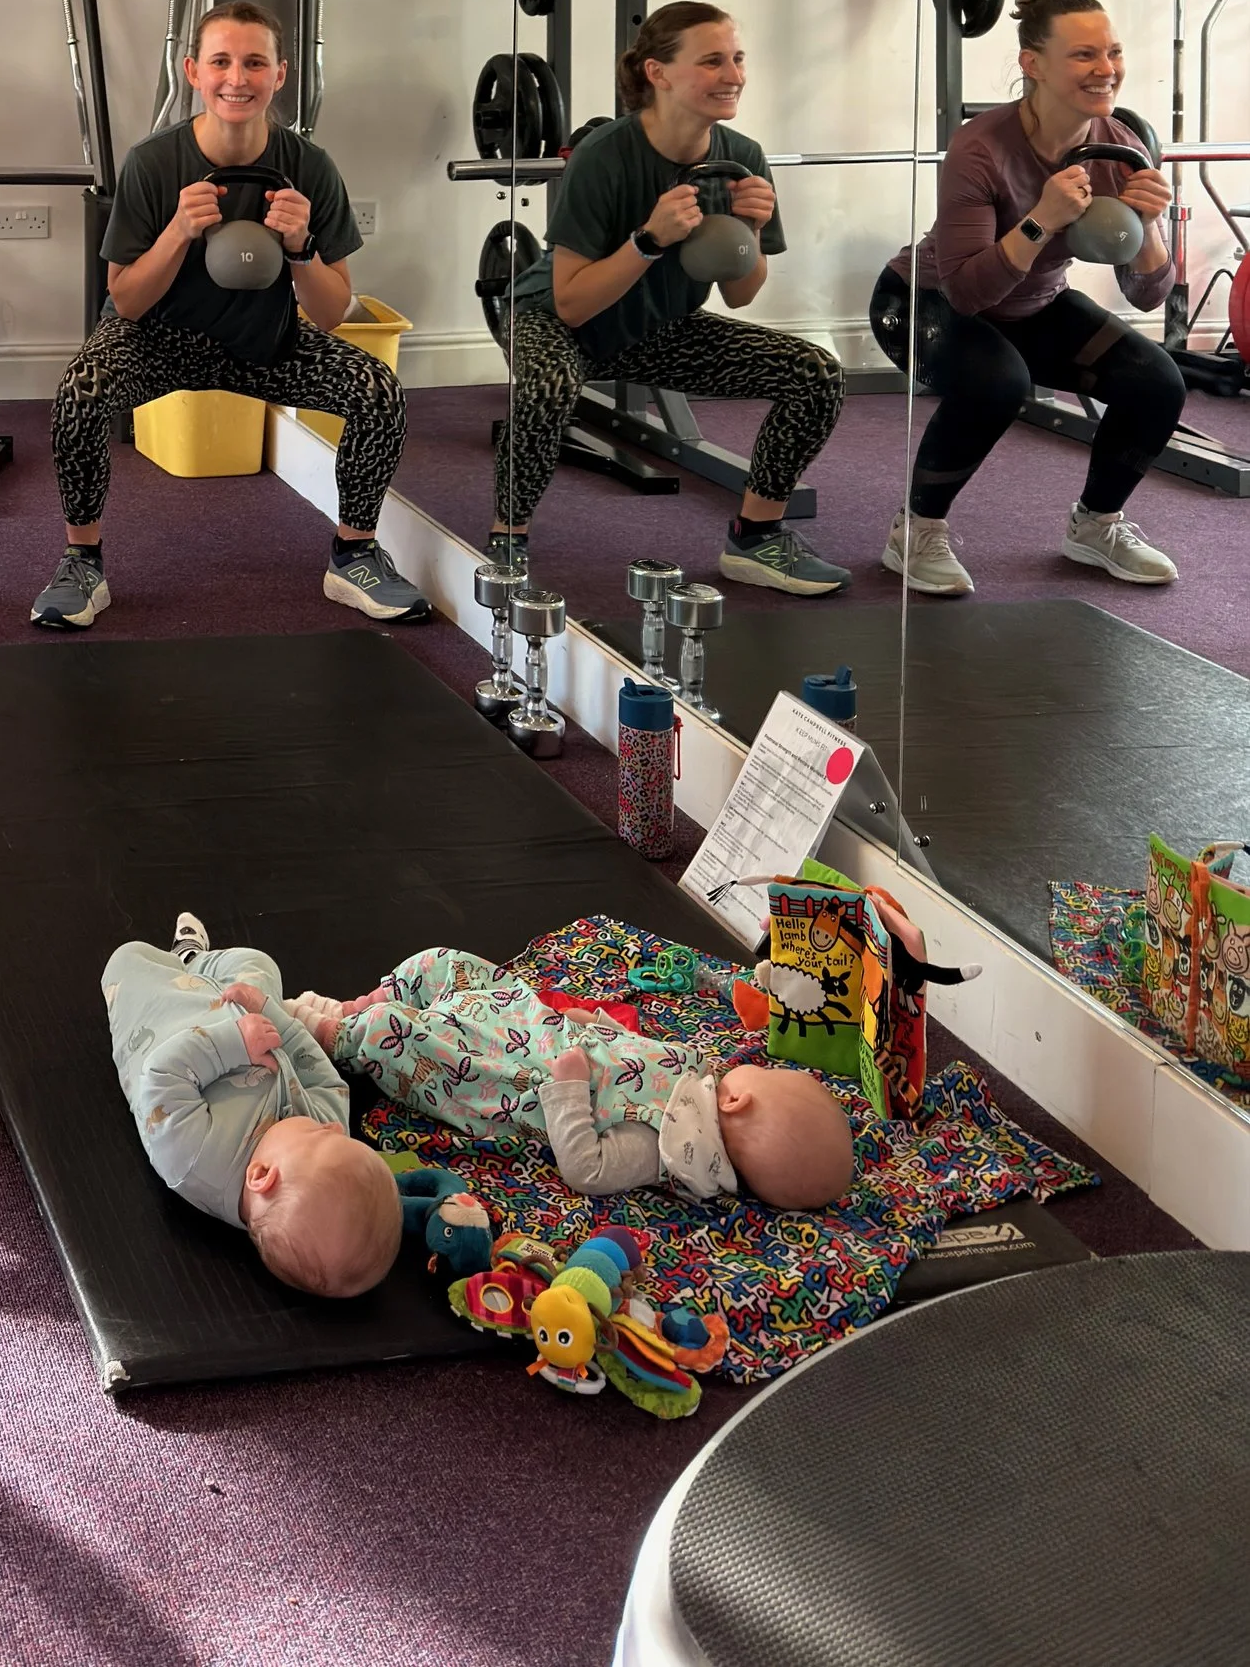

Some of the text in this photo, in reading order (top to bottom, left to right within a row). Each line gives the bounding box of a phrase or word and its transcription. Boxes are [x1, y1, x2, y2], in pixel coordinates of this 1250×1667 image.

[240, 252, 254, 263] 10
[803, 716, 827, 735] CAMPBELL
[827, 731, 847, 747] FITNESS
[775, 917, 806, 929] Hello
[779, 930, 807, 942] lamb
[781, 942, 817, 960] where's
[795, 953, 856, 969] your tail?
